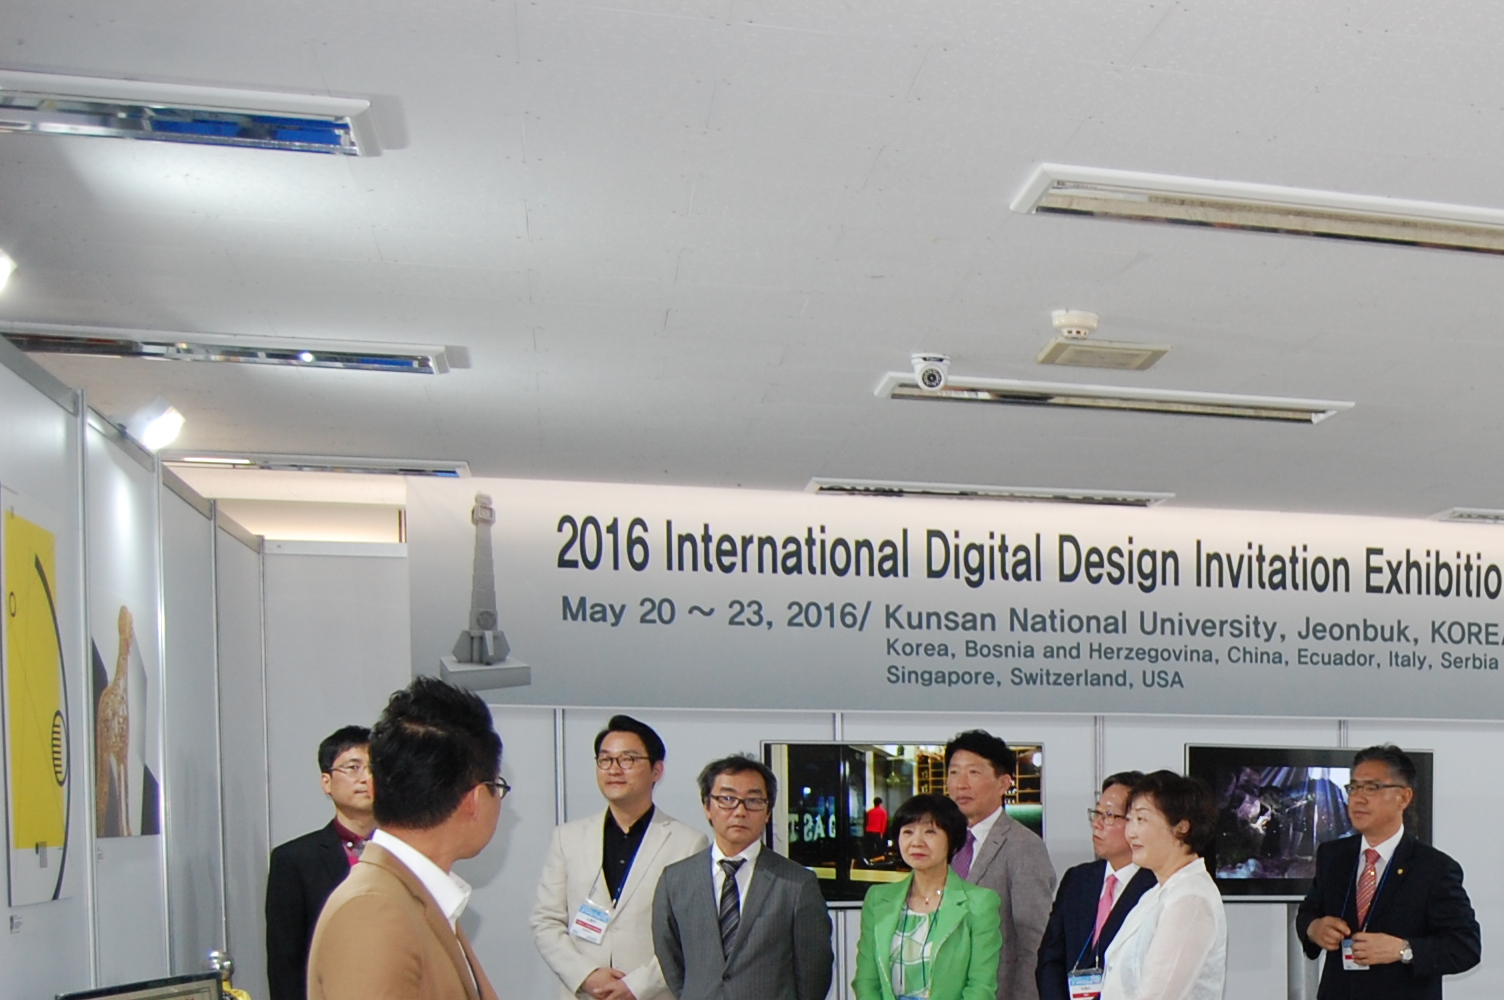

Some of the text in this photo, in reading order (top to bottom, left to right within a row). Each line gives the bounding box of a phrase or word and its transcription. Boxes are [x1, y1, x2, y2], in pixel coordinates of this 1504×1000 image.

[556, 514, 650, 572] 2016
[665, 518, 909, 579] International
[925, 528, 1042, 589] Digital
[1058, 533, 1180, 594] Design
[1195, 538, 1351, 594] Invitation
[561, 595, 627, 628] May
[639, 597, 676, 625] 20
[728, 599, 773, 631] 23,
[786, 600, 872, 632] 2016/
[884, 603, 997, 632] Kunsan
[1009, 607, 1127, 635] National
[1139, 610, 1286, 643] University,
[1297, 616, 1419, 647] Jeonbuk,
[886, 637, 1499, 671] Korea, Bosnia and Herzegovina, China, Ecuador, Italy, Serbia
[886, 665, 1185, 690] Singapore, Switzerland, USA
